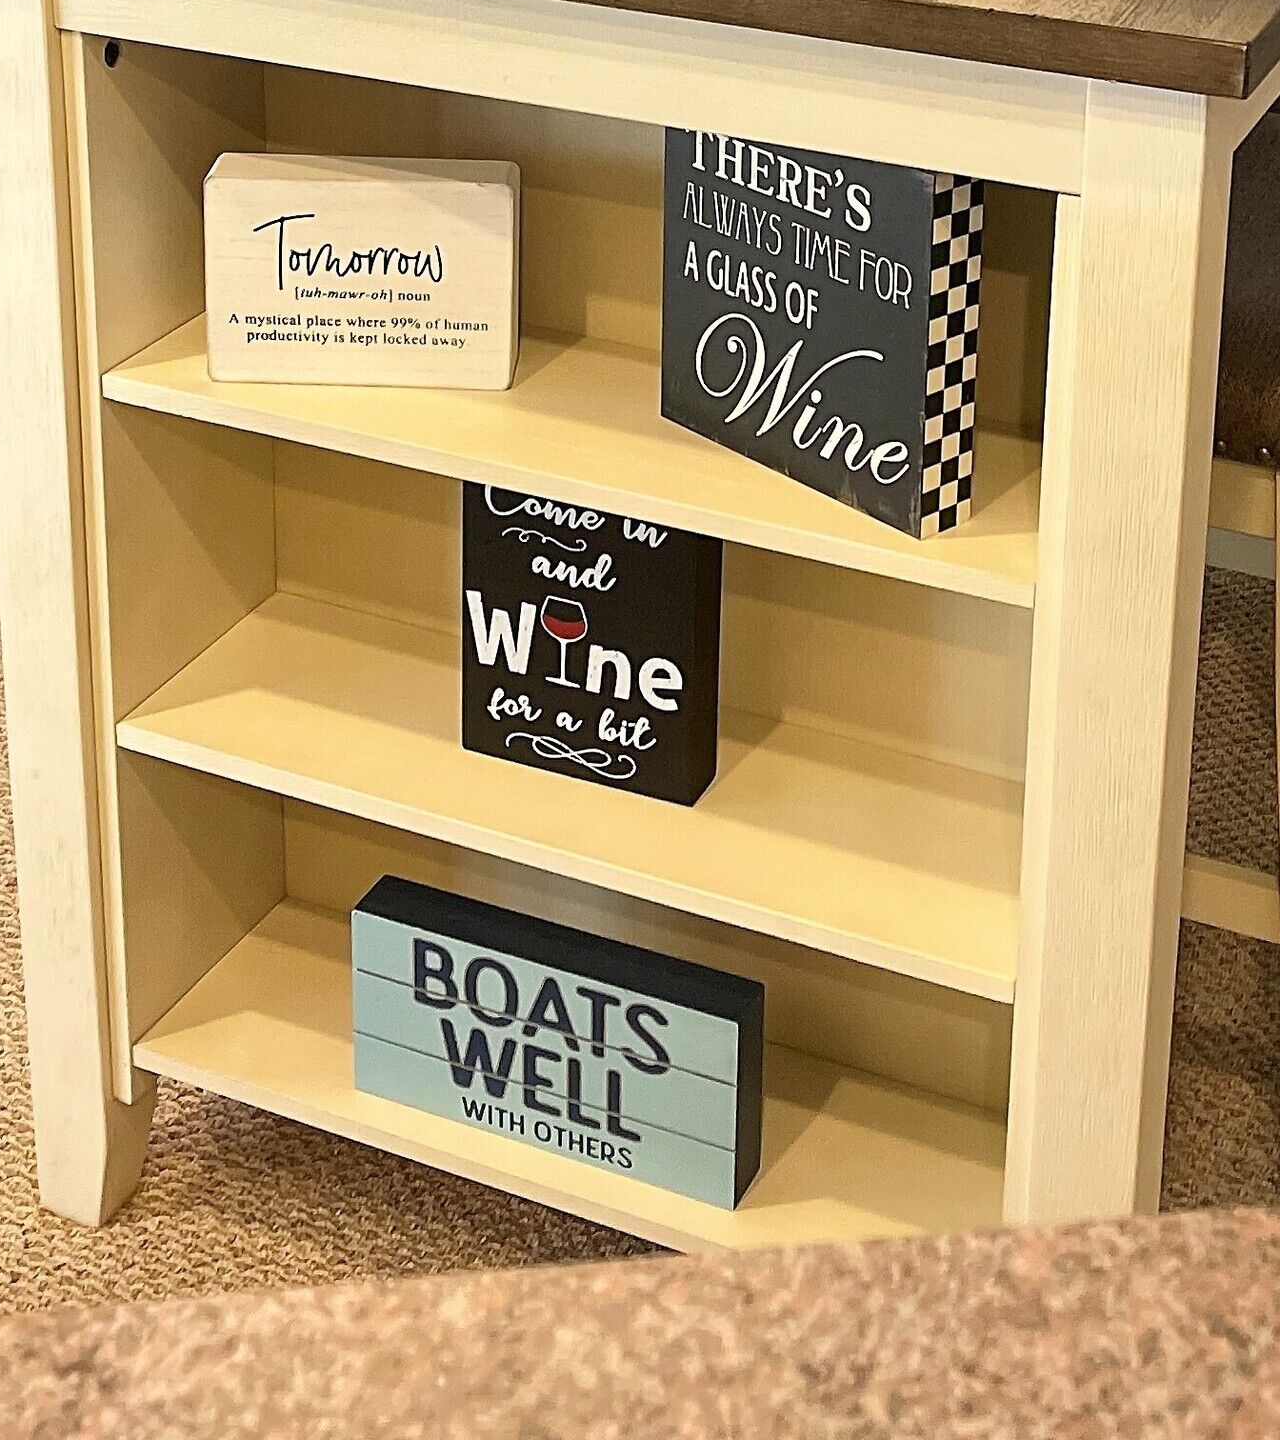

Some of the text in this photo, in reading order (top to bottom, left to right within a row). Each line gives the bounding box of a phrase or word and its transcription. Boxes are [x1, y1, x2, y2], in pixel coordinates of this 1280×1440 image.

[684, 128, 871, 232] THERE'S
[253, 213, 443, 291] Tomorrow
[683, 181, 912, 310] ALWAYS TIME FOR
[228, 313, 489, 332] A mystical place where 99% of human
[398, 292, 431, 302] noun
[683, 240, 819, 330] A GLASS OF
[247, 330, 329, 345] productivity
[334, 331, 345, 343] is
[349, 332, 379, 347] kept
[383, 333, 427, 346] locked
[695, 313, 910, 485] Wine
[485, 485, 606, 530] Come
[532, 553, 617, 592] and
[487, 687, 657, 751] for a bit
[413, 937, 670, 1075] BOATS
[440, 1017, 642, 1143] WELL
[462, 1096, 634, 1170] WITH OTHERS
